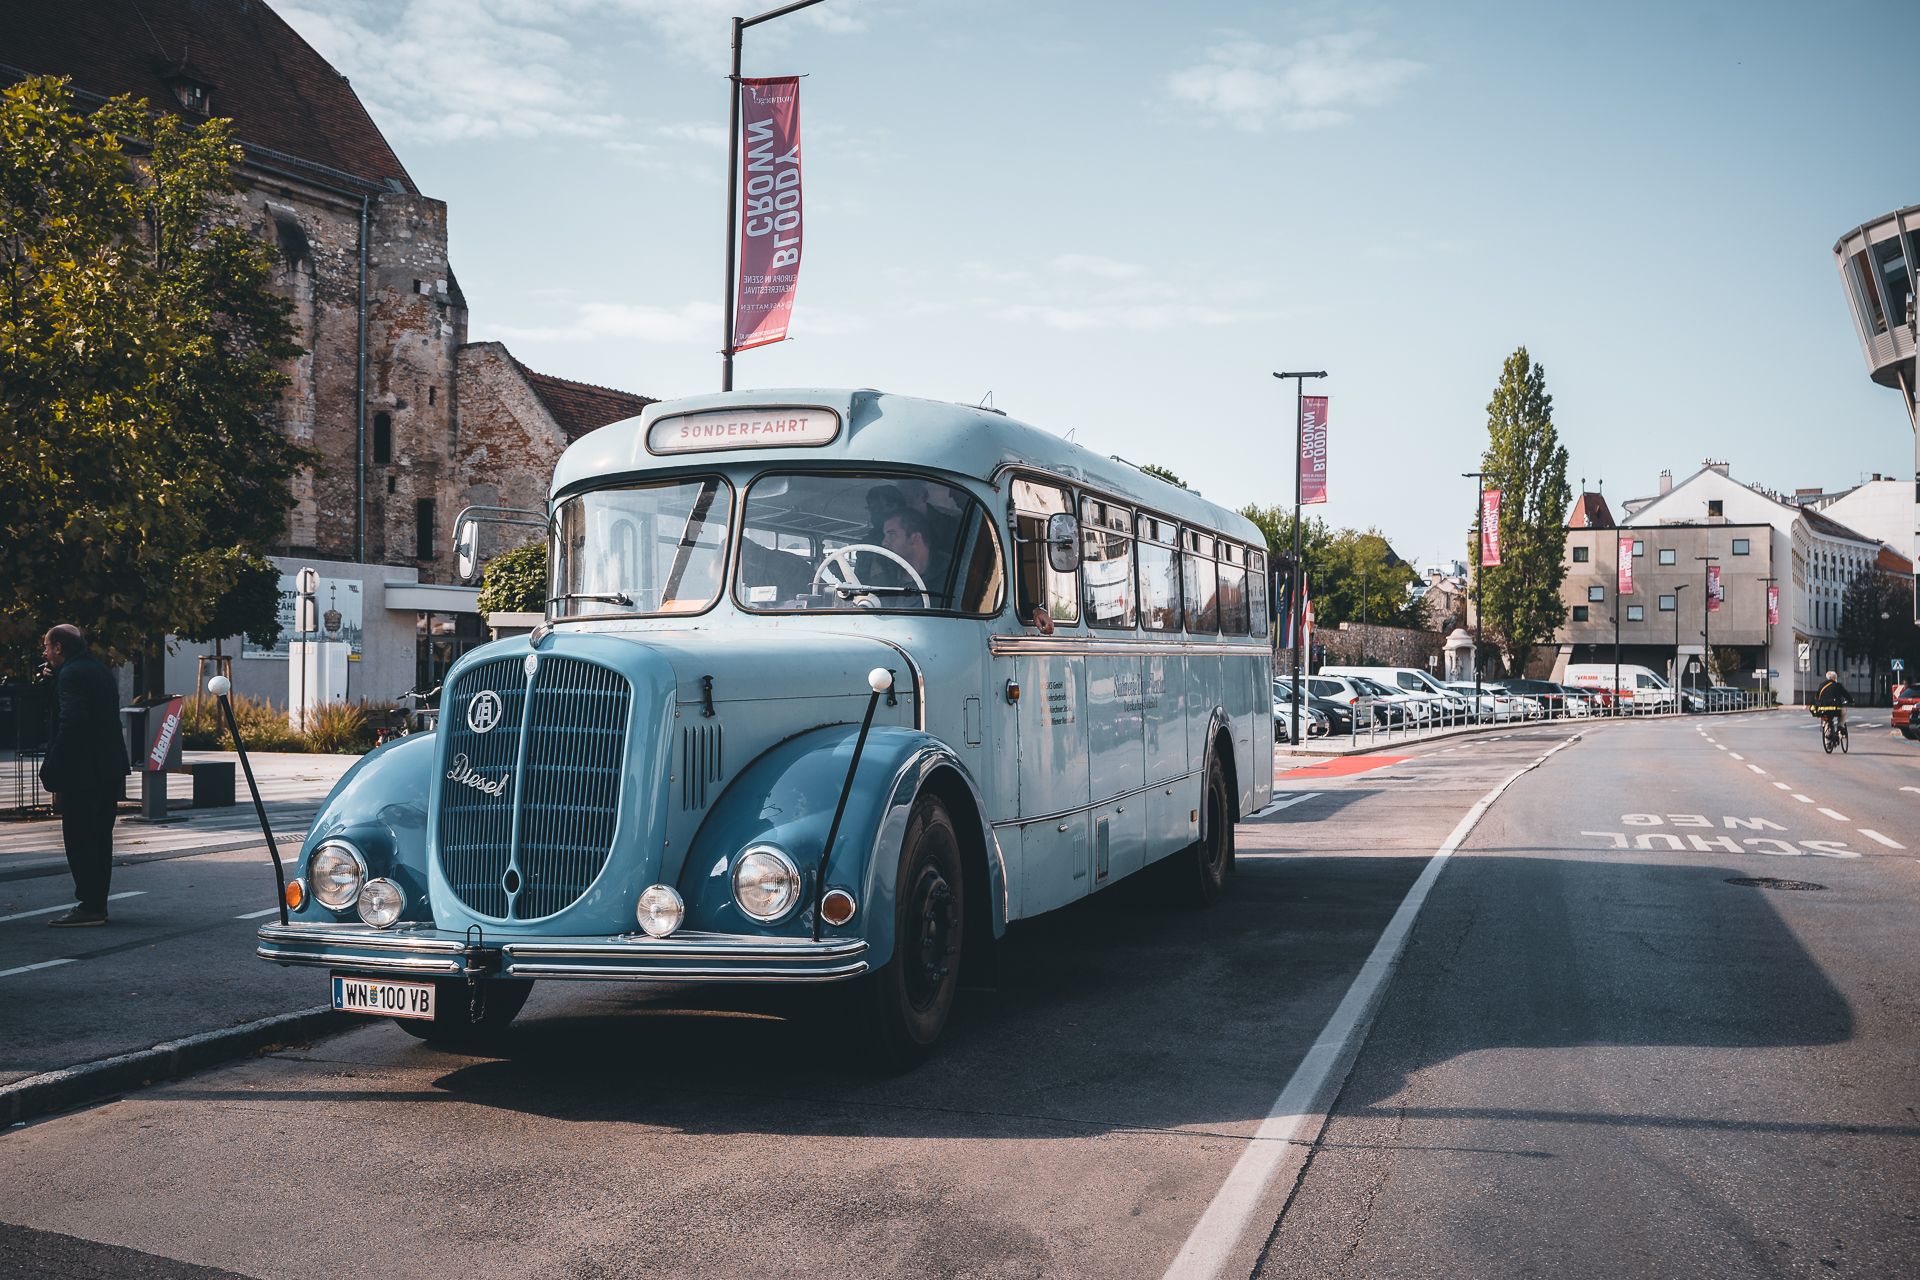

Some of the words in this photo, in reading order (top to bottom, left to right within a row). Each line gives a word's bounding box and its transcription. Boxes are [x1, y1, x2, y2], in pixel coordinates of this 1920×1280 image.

[680, 418, 809, 439] SONDERFAHRT
[150, 714, 177, 764] Heute
[447, 753, 509, 796] Diesel
[1621, 813, 1788, 831] WEG
[1581, 831, 1862, 858] SCHUL
[346, 983, 368, 1007] WN
[379, 985, 406, 1010] 100
[410, 988, 430, 1013] VB
